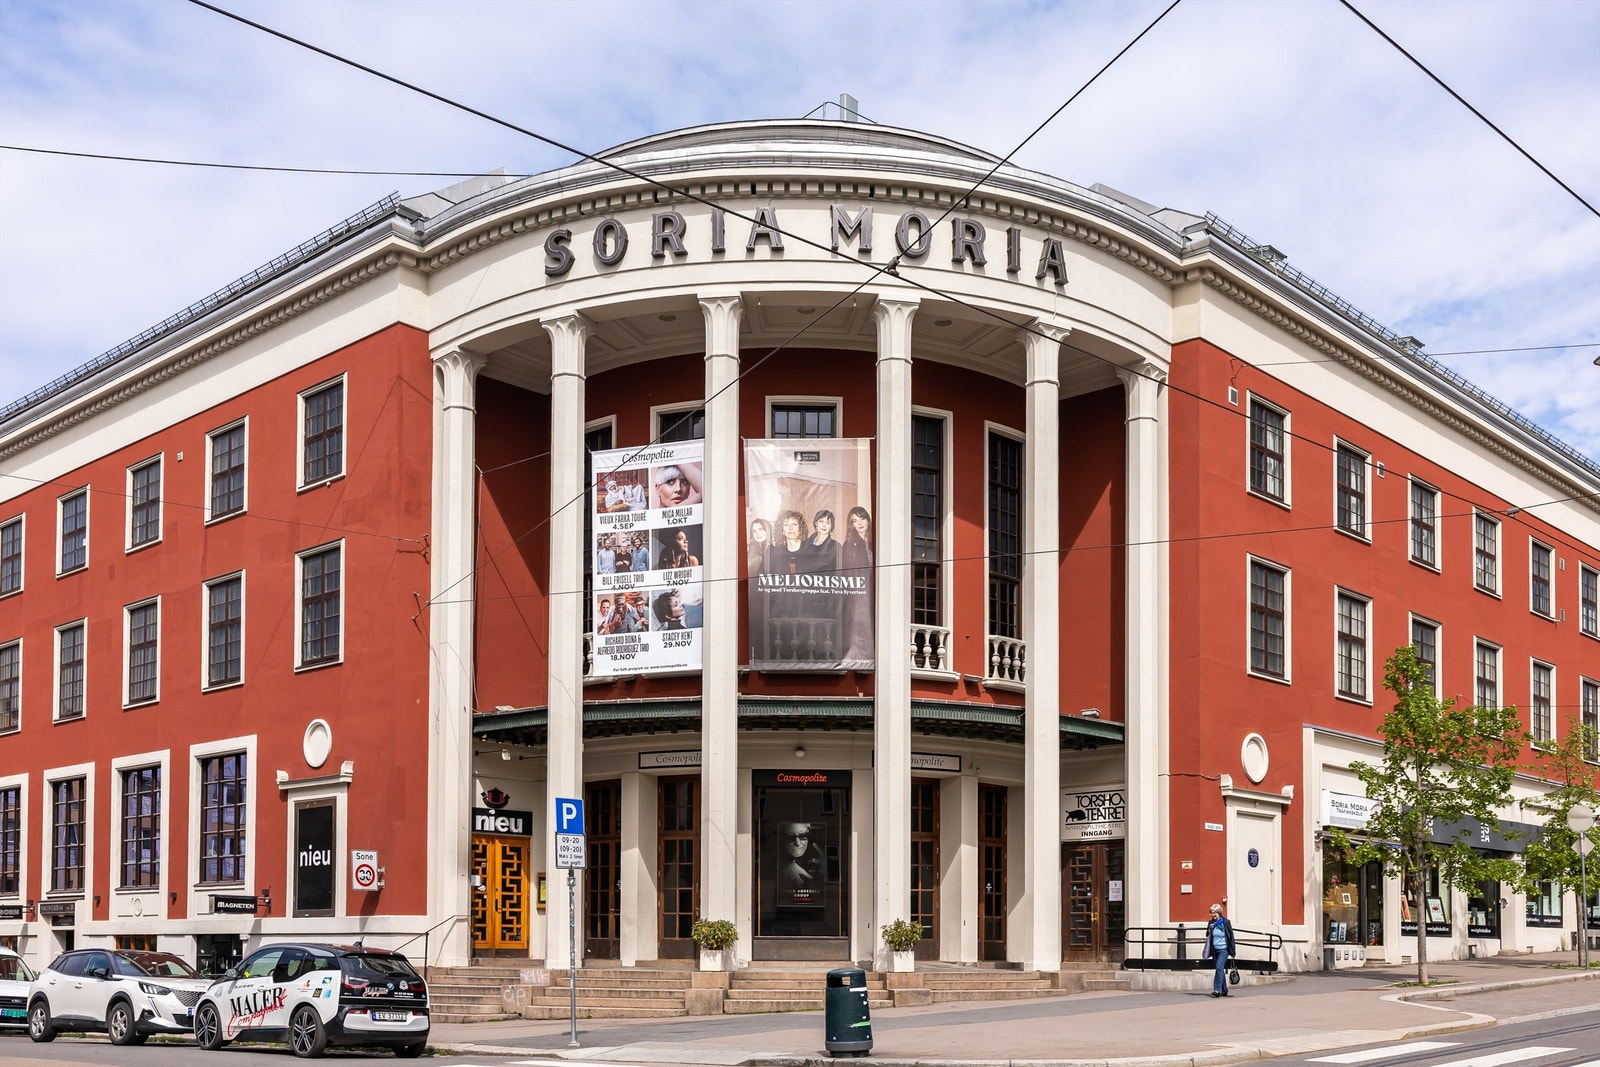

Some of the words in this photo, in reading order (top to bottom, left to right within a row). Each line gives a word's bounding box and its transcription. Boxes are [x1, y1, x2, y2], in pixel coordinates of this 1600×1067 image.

[543, 205, 785, 278] SORIA
[830, 204, 1069, 287] MORIA
[622, 448, 674, 464] Cosmopolite
[600, 515, 614, 524] VIEUX
[614, 514, 630, 523] FARKA
[631, 511, 646, 522] TOURÉ
[662, 509, 674, 519] MICA
[675, 507, 692, 517] MILLAR
[612, 522, 634, 530] 4.SEP
[667, 517, 687, 525] 1.OKT
[602, 576, 612, 586] BILL
[613, 574, 631, 584] FRISELL
[633, 573, 644, 583] TRIO
[663, 571, 672, 581] LIZZ
[673, 569, 692, 579] WRIGHT
[758, 573, 866, 589] MELIORISME
[605, 635, 624, 645] RICHARD
[625, 634, 637, 644] BONA
[638, 634, 642, 644] &
[662, 632, 680, 642] STACEY
[681, 631, 693, 641] KENT
[597, 645, 615, 655] ALFREDO
[616, 643, 639, 654] RODRIGUEZ
[640, 643, 649, 652] TRIO
[663, 640, 692, 648] 29.NOV
[610, 653, 636, 661] 18.NOV
[777, 772, 828, 786] Cosmopolite
[1331, 799, 1349, 809] SORIA
[1350, 803, 1368, 812] MORIA
[562, 803, 577, 830] P
[1085, 806, 1125, 821] TEATRET
[475, 809, 523, 834] nieu
[299, 844, 331, 867] nieu
[356, 852, 374, 861] Sone
[359, 869, 373, 882] 30
[217, 901, 255, 910] MAGNETEN
[229, 987, 285, 1018] MALER
[378, 1011, 386, 1019] EV
